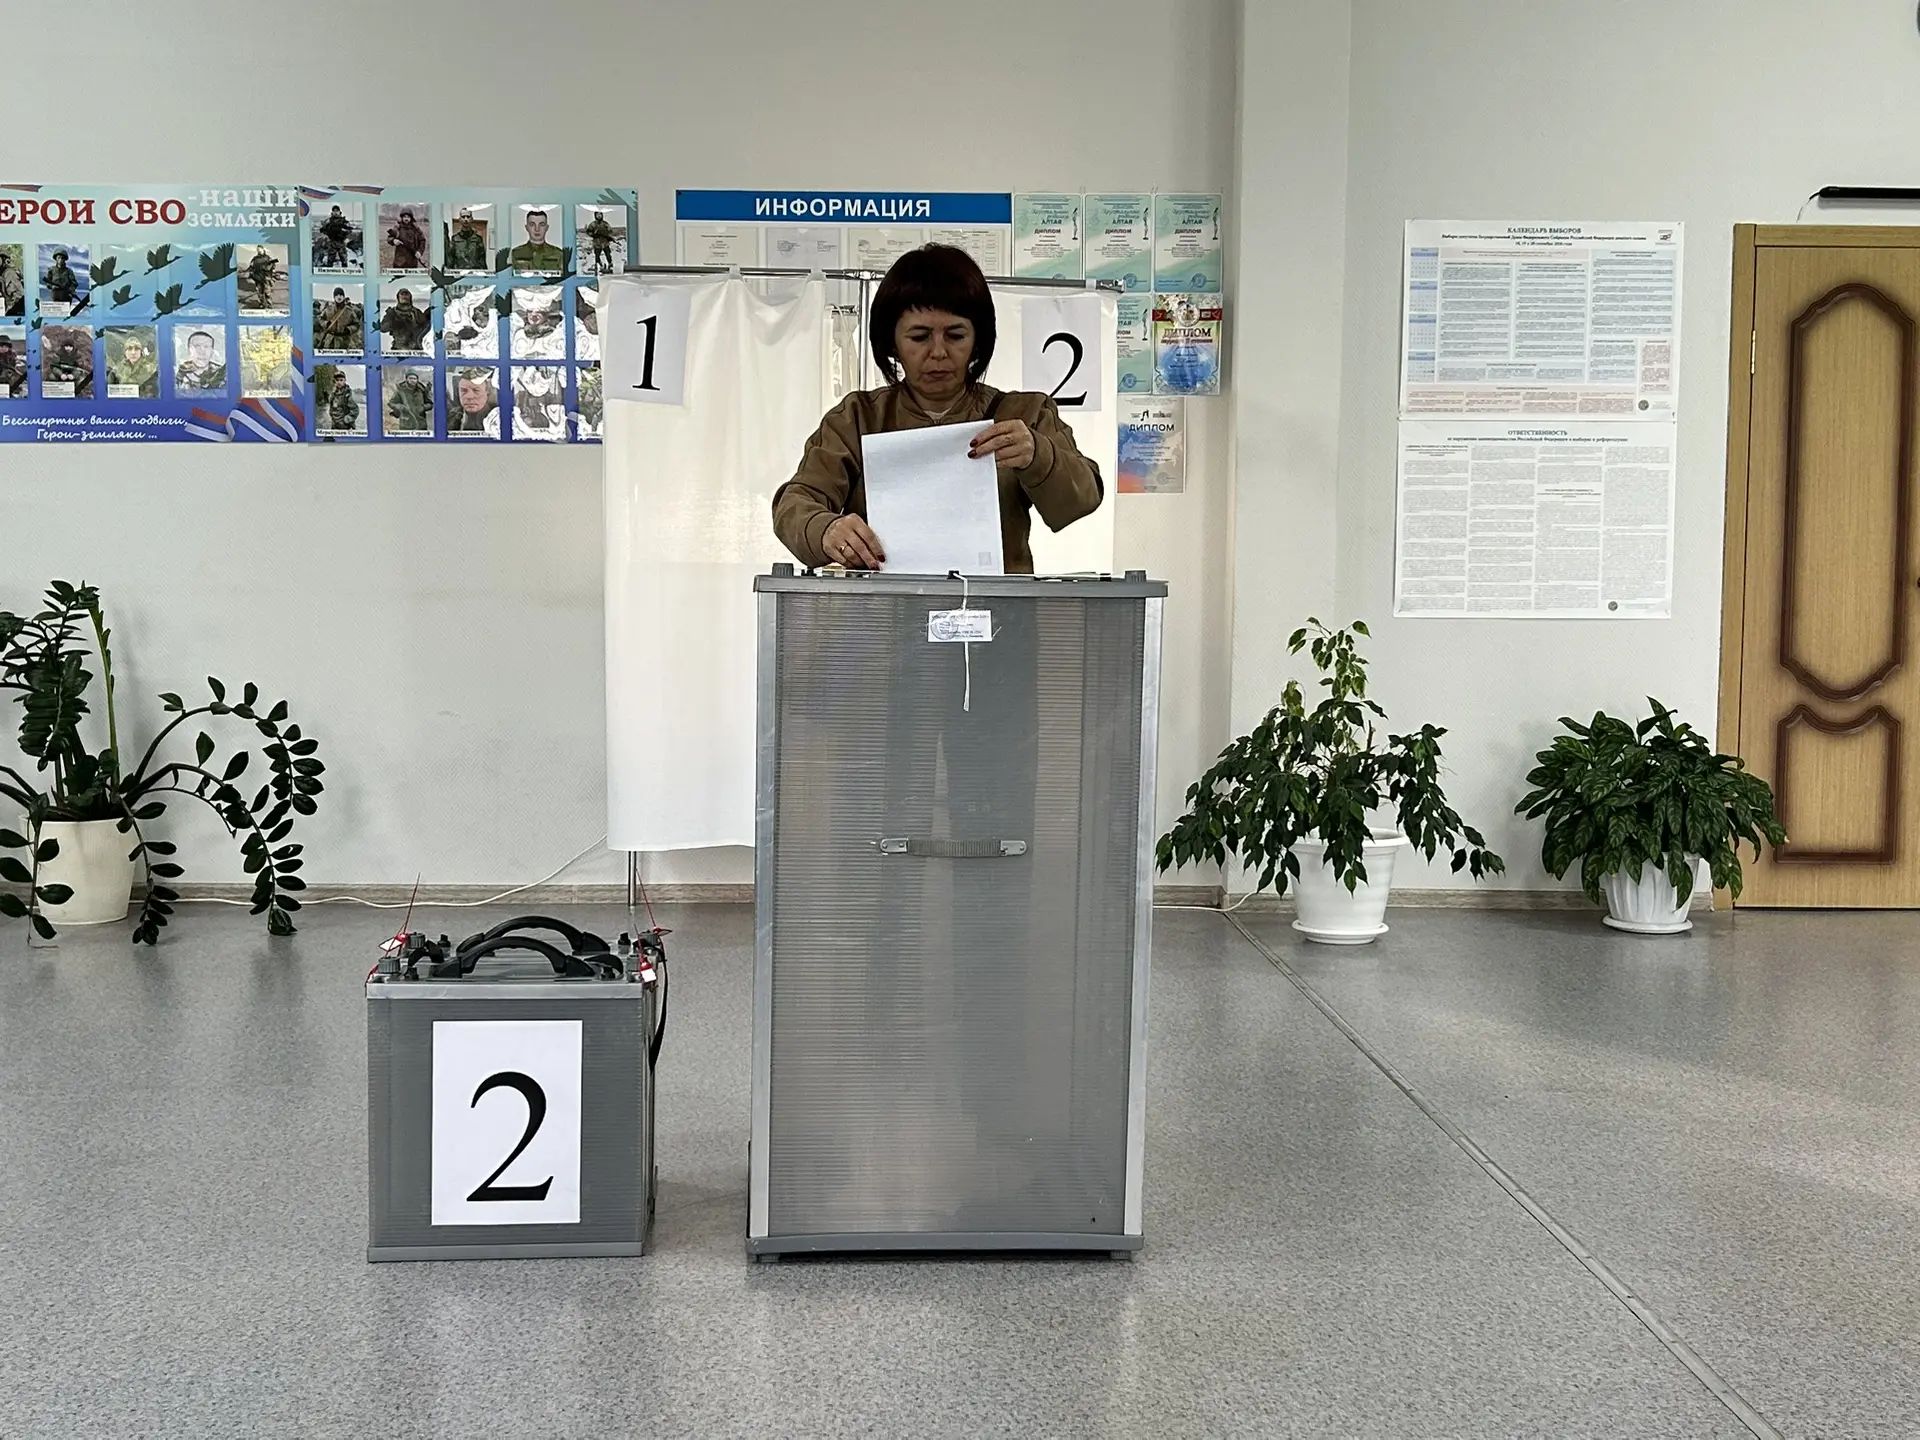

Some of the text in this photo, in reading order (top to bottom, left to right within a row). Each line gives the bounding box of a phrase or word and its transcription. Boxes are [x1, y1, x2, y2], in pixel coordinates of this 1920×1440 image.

[188, 188, 299, 207] -наши
[108, 198, 187, 226] СВО
[755, 197, 931, 220] ИНФОРМАЦИЯ
[187, 211, 297, 229] земляки
[1162, 327, 1212, 338] ДИПЛОМ
[632, 315, 661, 391] 1
[1042, 332, 1088, 406] 2
[2, 414, 188, 428] Бессмертны ваши подвиги,
[1129, 424, 1175, 432] ДИПЛОМ
[37, 429, 145, 442] Герои-земляки
[466, 1071, 554, 1202] 2
